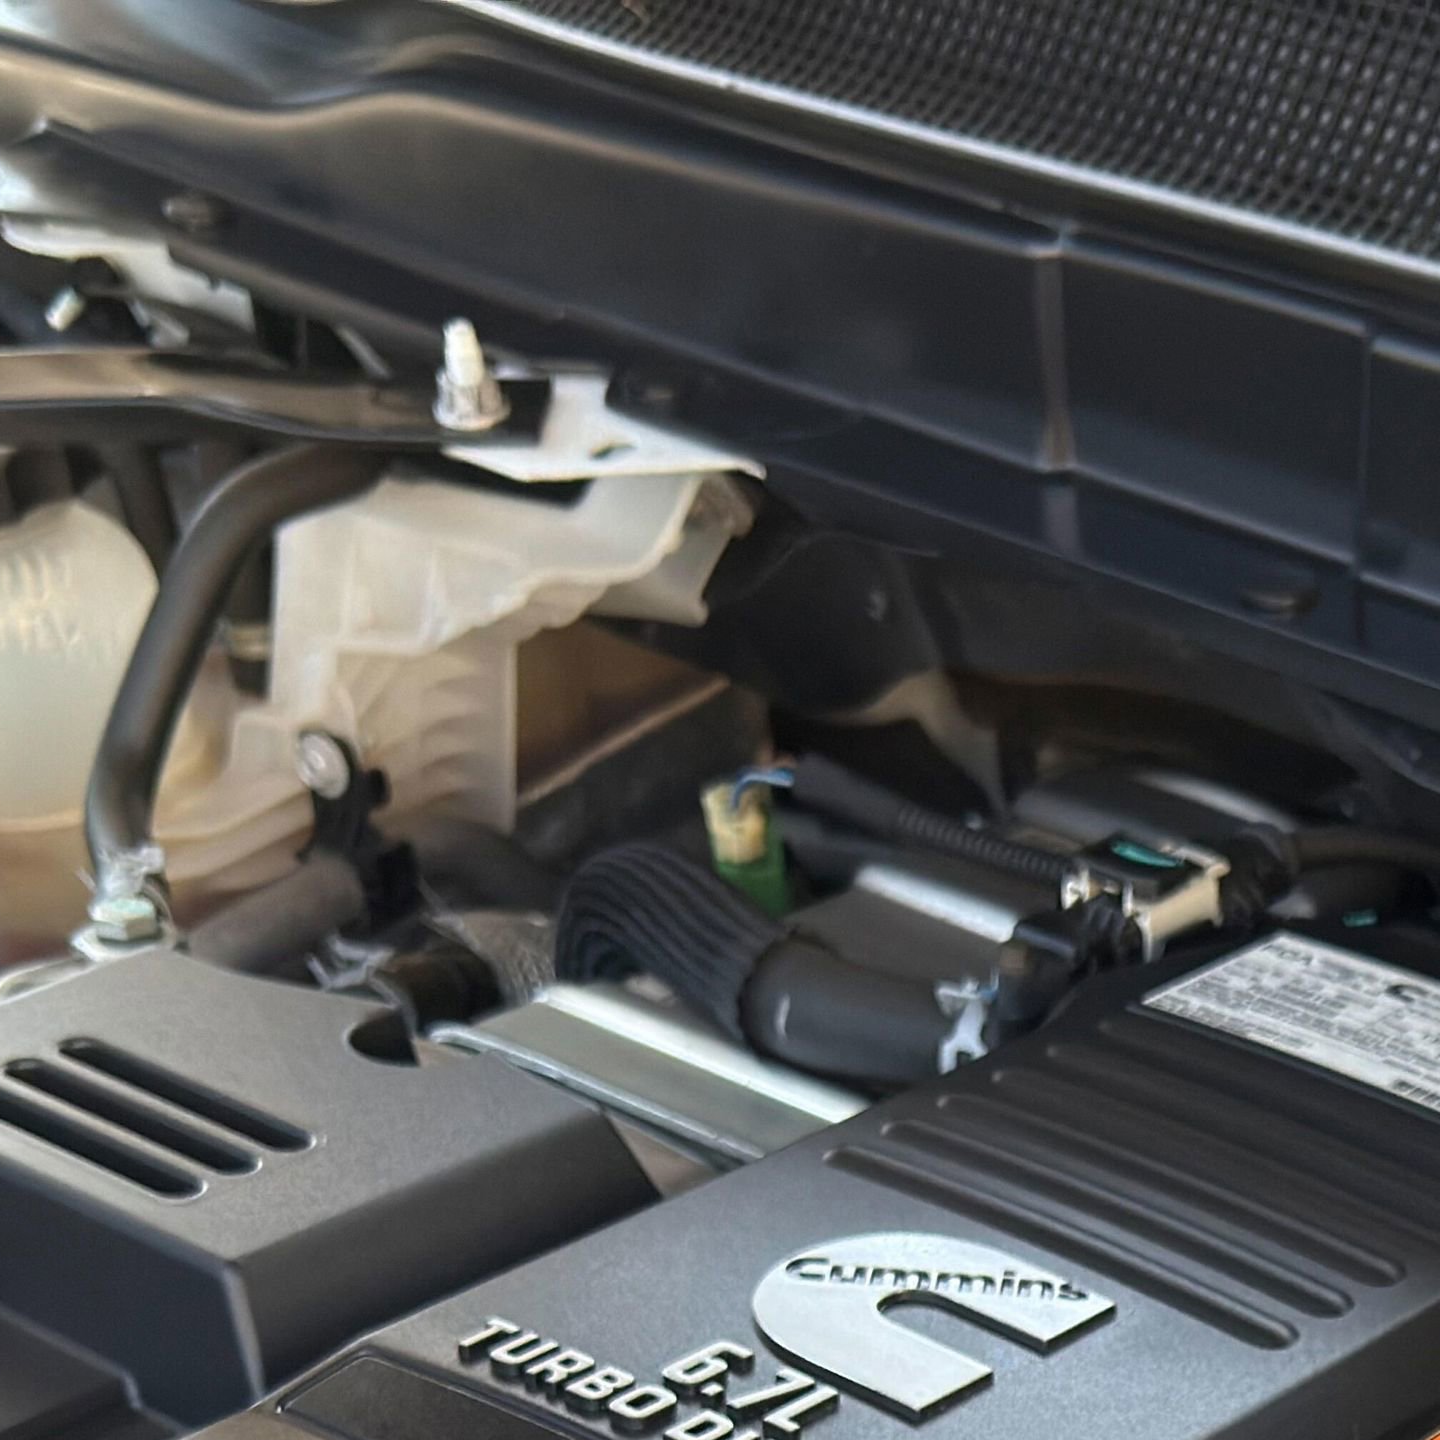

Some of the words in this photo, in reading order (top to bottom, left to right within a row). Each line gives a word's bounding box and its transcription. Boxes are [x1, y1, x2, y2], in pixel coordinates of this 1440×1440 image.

[785, 1257, 1089, 1300] Cummins
[458, 1316, 678, 1425] TURBO
[661, 1339, 840, 1437] 6.7L
